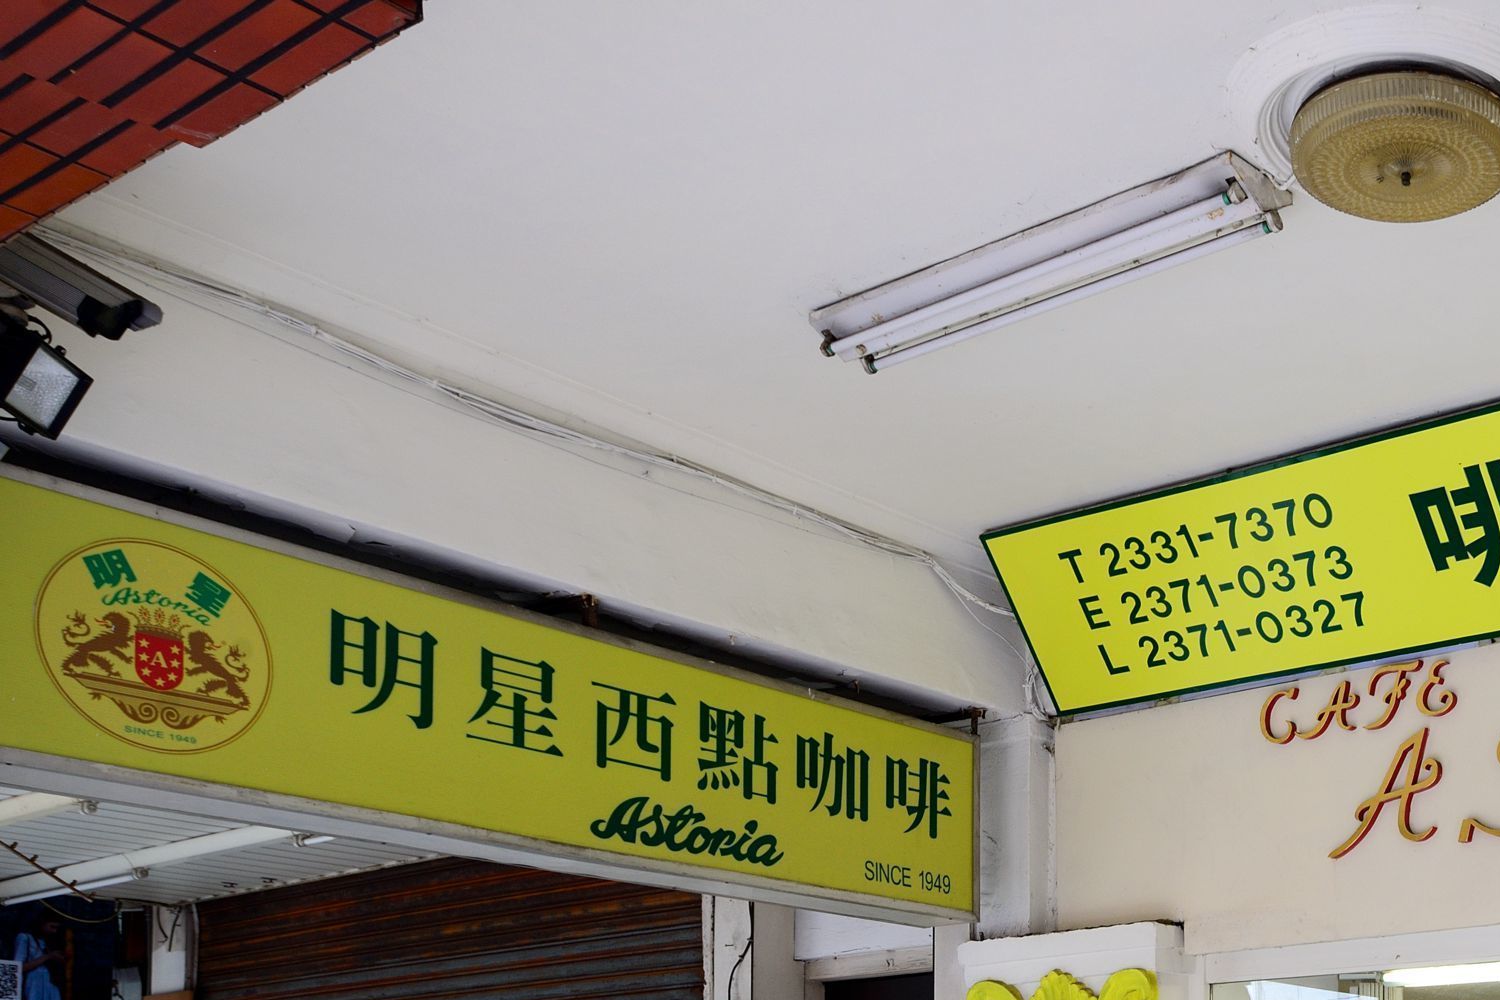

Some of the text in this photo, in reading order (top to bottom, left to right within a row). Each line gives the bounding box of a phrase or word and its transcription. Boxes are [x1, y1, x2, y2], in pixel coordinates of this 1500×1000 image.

[1058, 493, 1333, 583] T 2331-7370
[101, 587, 210, 626] Astoria
[1078, 545, 1353, 630] E 2371-0373
[151, 651, 168, 669] A
[1098, 591, 1367, 675] L 2371-0327
[124, 725, 197, 744] SINCE 1949
[331, 608, 952, 839] 明星西點咖啡
[1260, 660, 1458, 744] CAFE
[590, 796, 784, 866] Astoria
[864, 860, 951, 894] SINCE 1949
